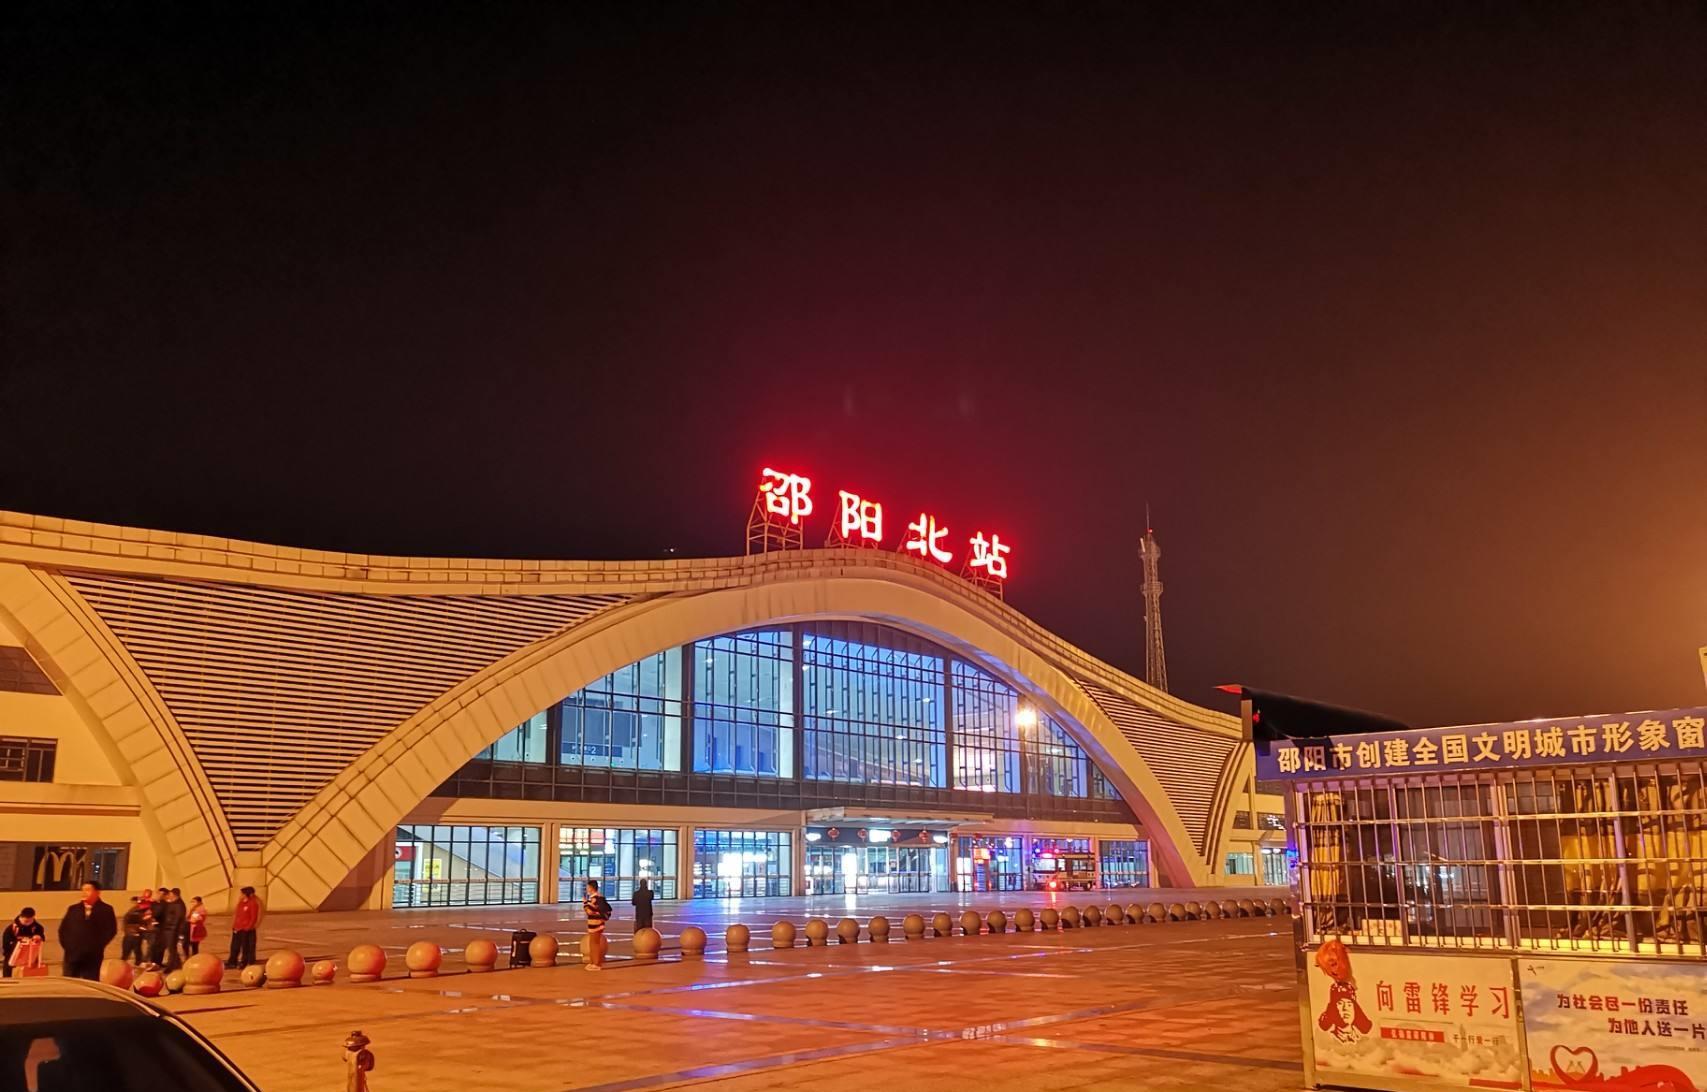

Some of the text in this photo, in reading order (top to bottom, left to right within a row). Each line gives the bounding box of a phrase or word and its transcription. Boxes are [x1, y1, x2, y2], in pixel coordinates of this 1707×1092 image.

[760, 468, 1011, 579] 邵阳北站
[1277, 716, 1705, 774] 邵阳市创建全国文明城市形象窗
[1376, 980, 1510, 1019] 向雷锋学习
[1607, 1017, 1706, 1040] 为他人送一片
